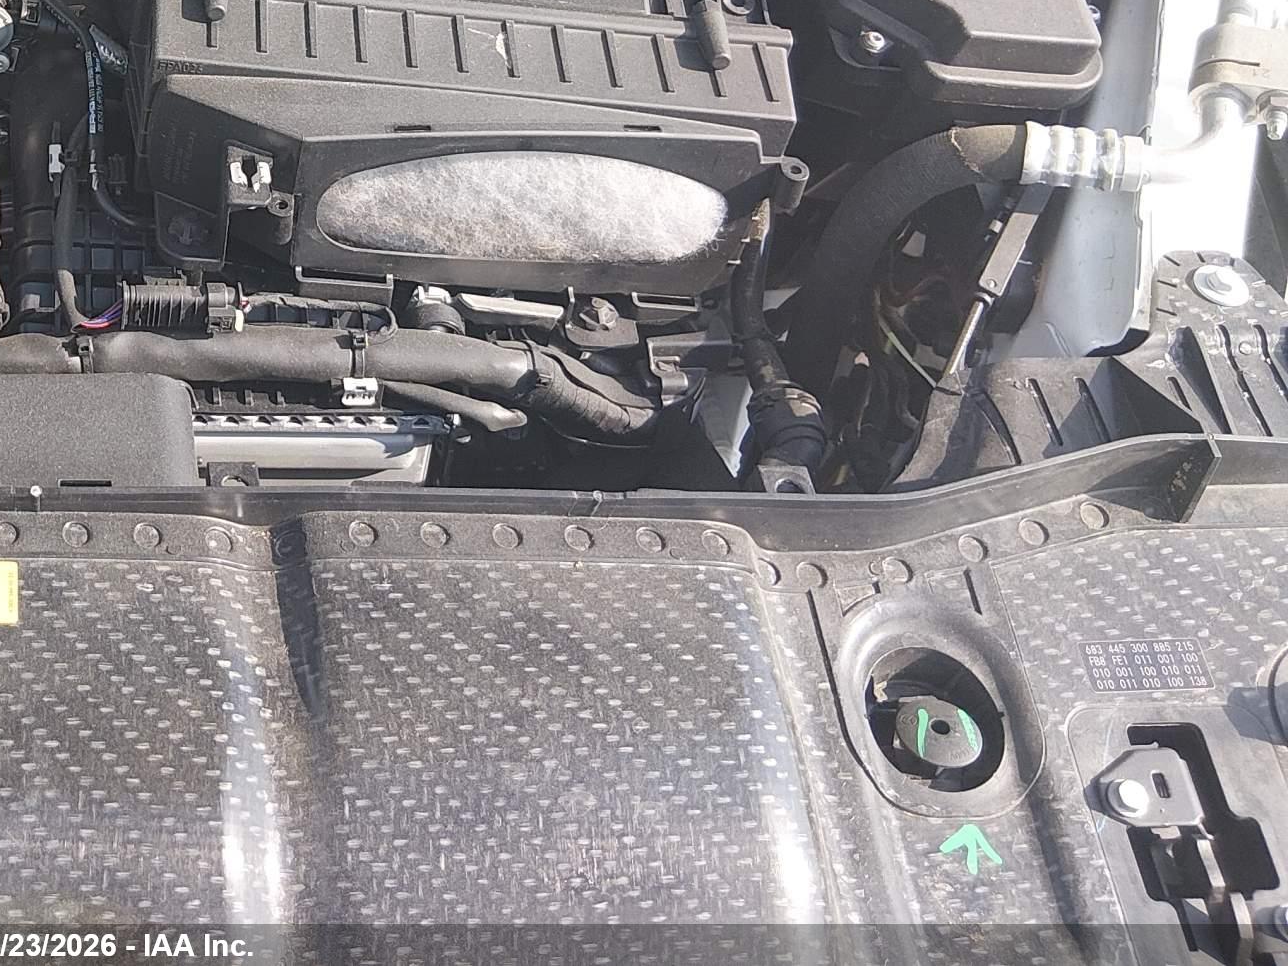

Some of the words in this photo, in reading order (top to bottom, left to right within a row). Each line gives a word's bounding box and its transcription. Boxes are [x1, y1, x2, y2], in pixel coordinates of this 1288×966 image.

[1108, 644, 1125, 653] 445
[1130, 643, 1148, 653] 300
[1175, 642, 1194, 651] 215
[1112, 655, 1128, 665] FE1
[1135, 654, 1152, 664] 011
[1158, 654, 1175, 664] 001
[1181, 653, 1198, 662] 100
[1092, 668, 1110, 678] 010
[1116, 667, 1134, 677] 001
[1140, 666, 1156, 676] 100
[1162, 666, 1179, 675] 010
[1185, 665, 1203, 674] 011
[1097, 680, 1114, 689] 010
[1120, 679, 1137, 689] 011
[1143, 678, 1160, 688] 010
[1167, 677, 1184, 687] 100
[1190, 676, 1207, 686] 138
